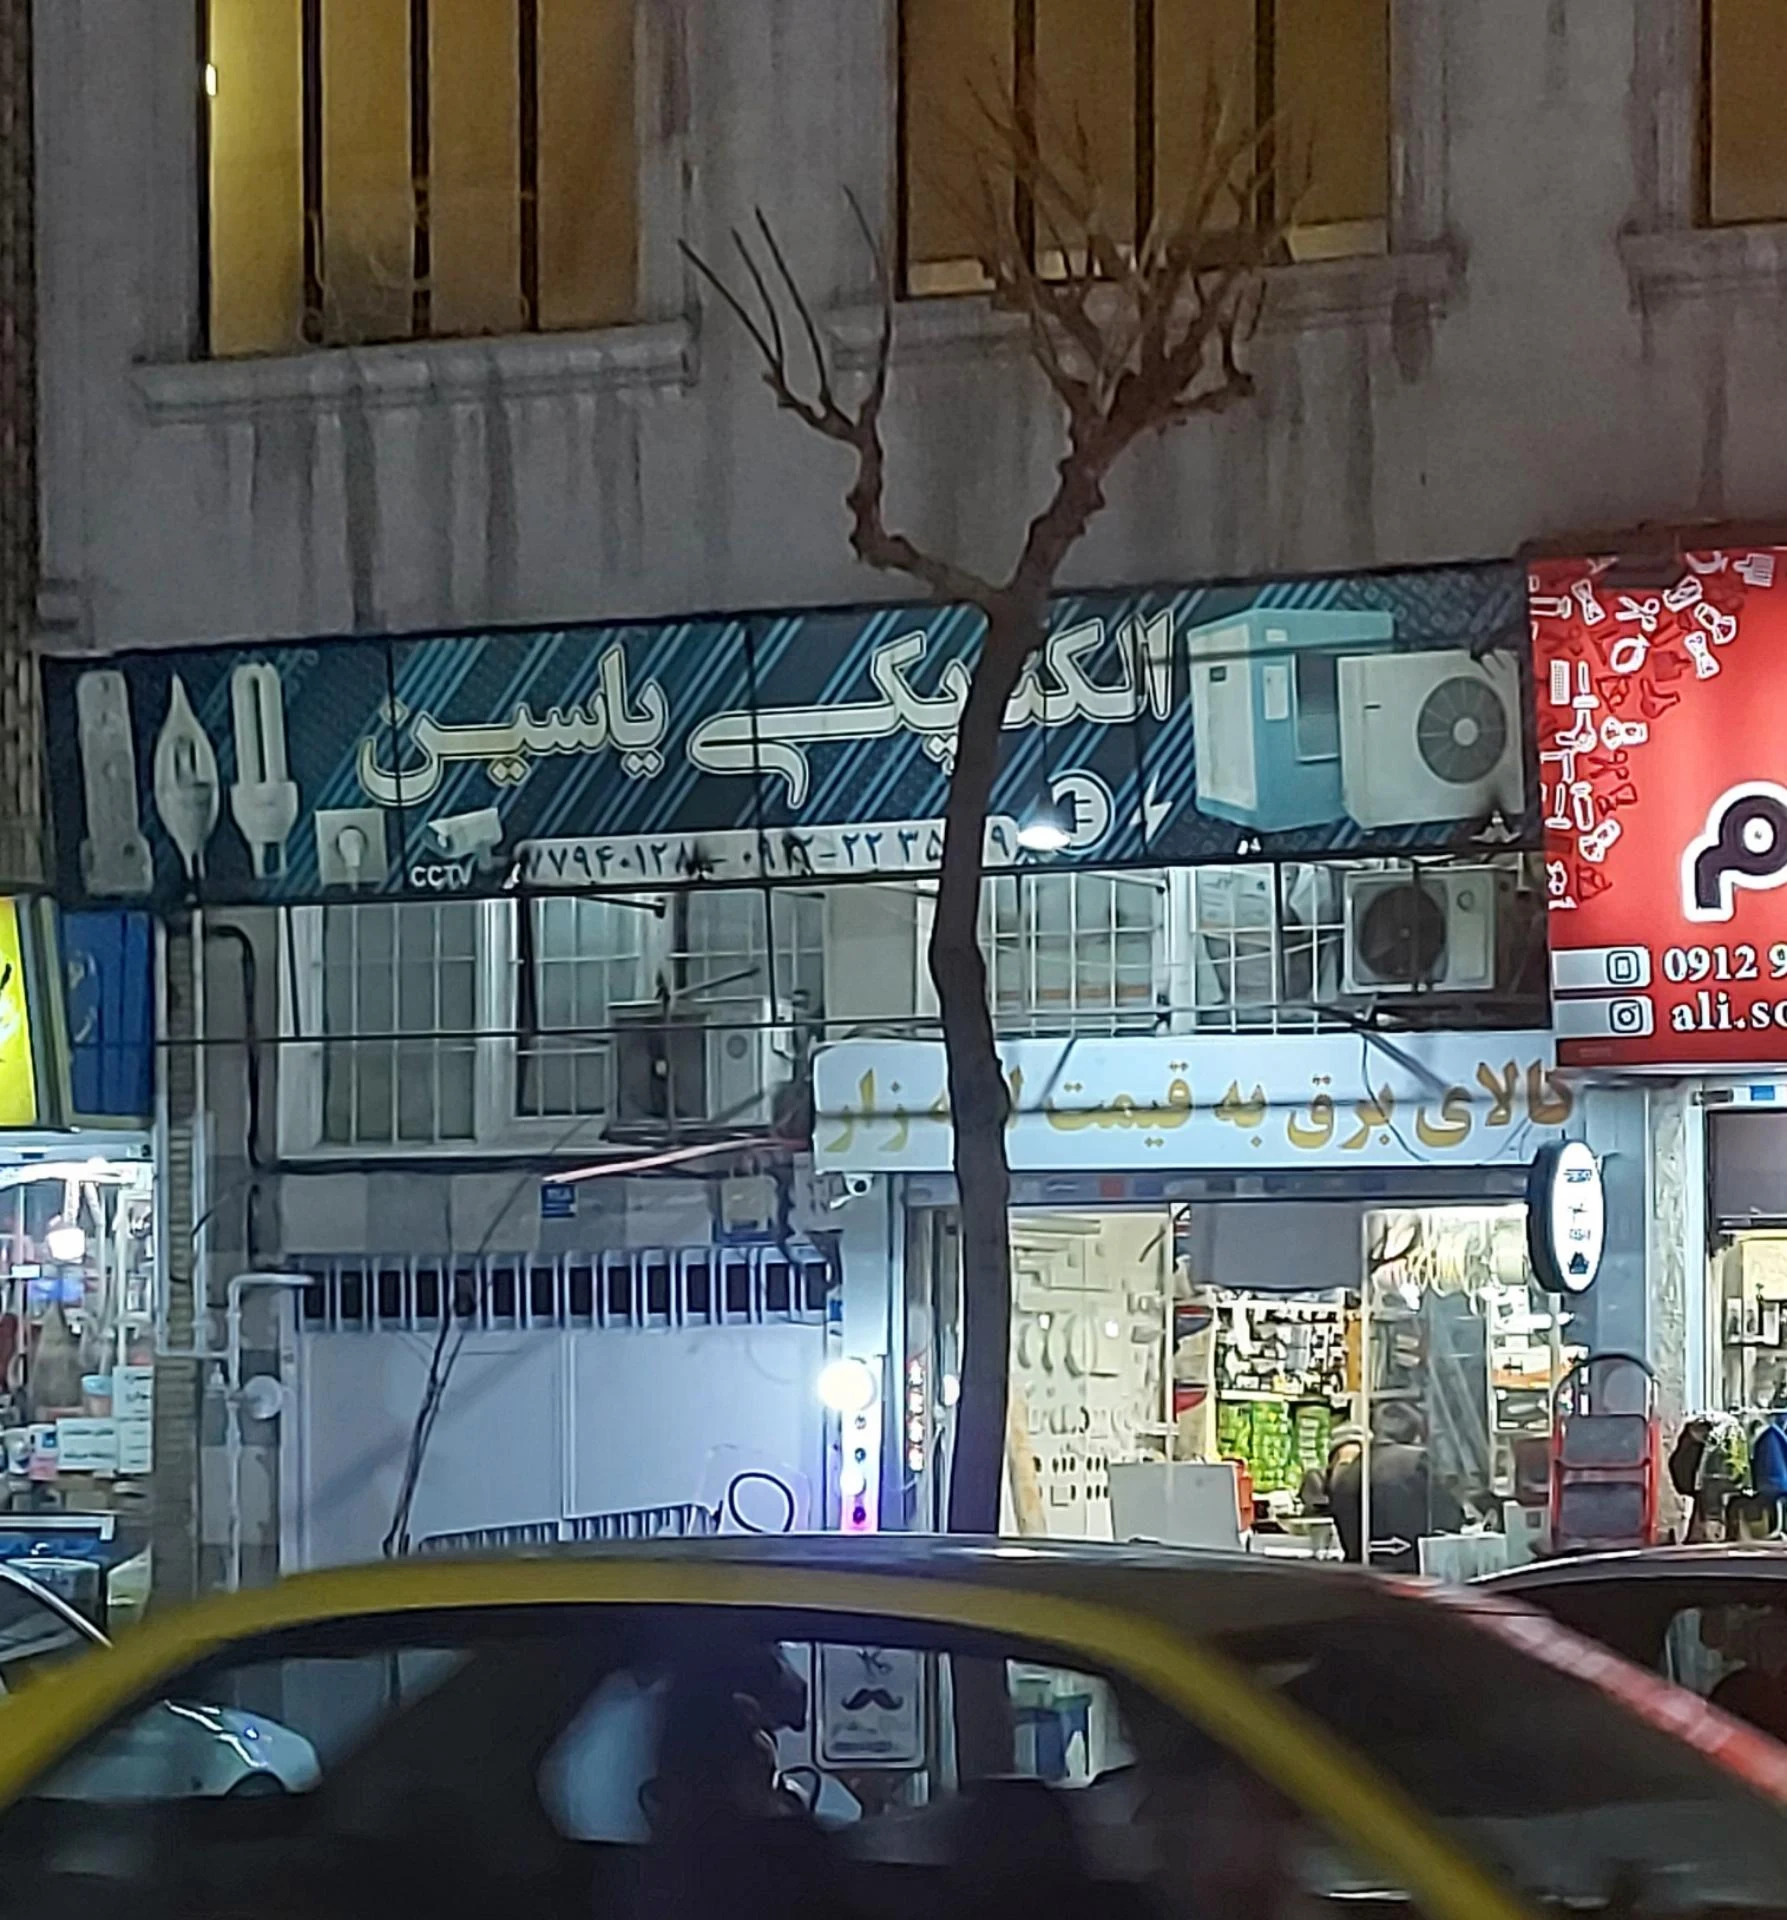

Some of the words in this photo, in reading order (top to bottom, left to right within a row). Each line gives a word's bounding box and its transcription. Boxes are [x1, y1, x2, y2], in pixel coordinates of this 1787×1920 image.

[356, 643, 669, 807] یاسین
[410, 864, 477, 888] CCTV
[1664, 945, 1758, 982] 0912
[1045, 1062, 1192, 1147] قیمت
[1214, 1080, 1267, 1147] به
[1287, 1074, 1394, 1150] برق
